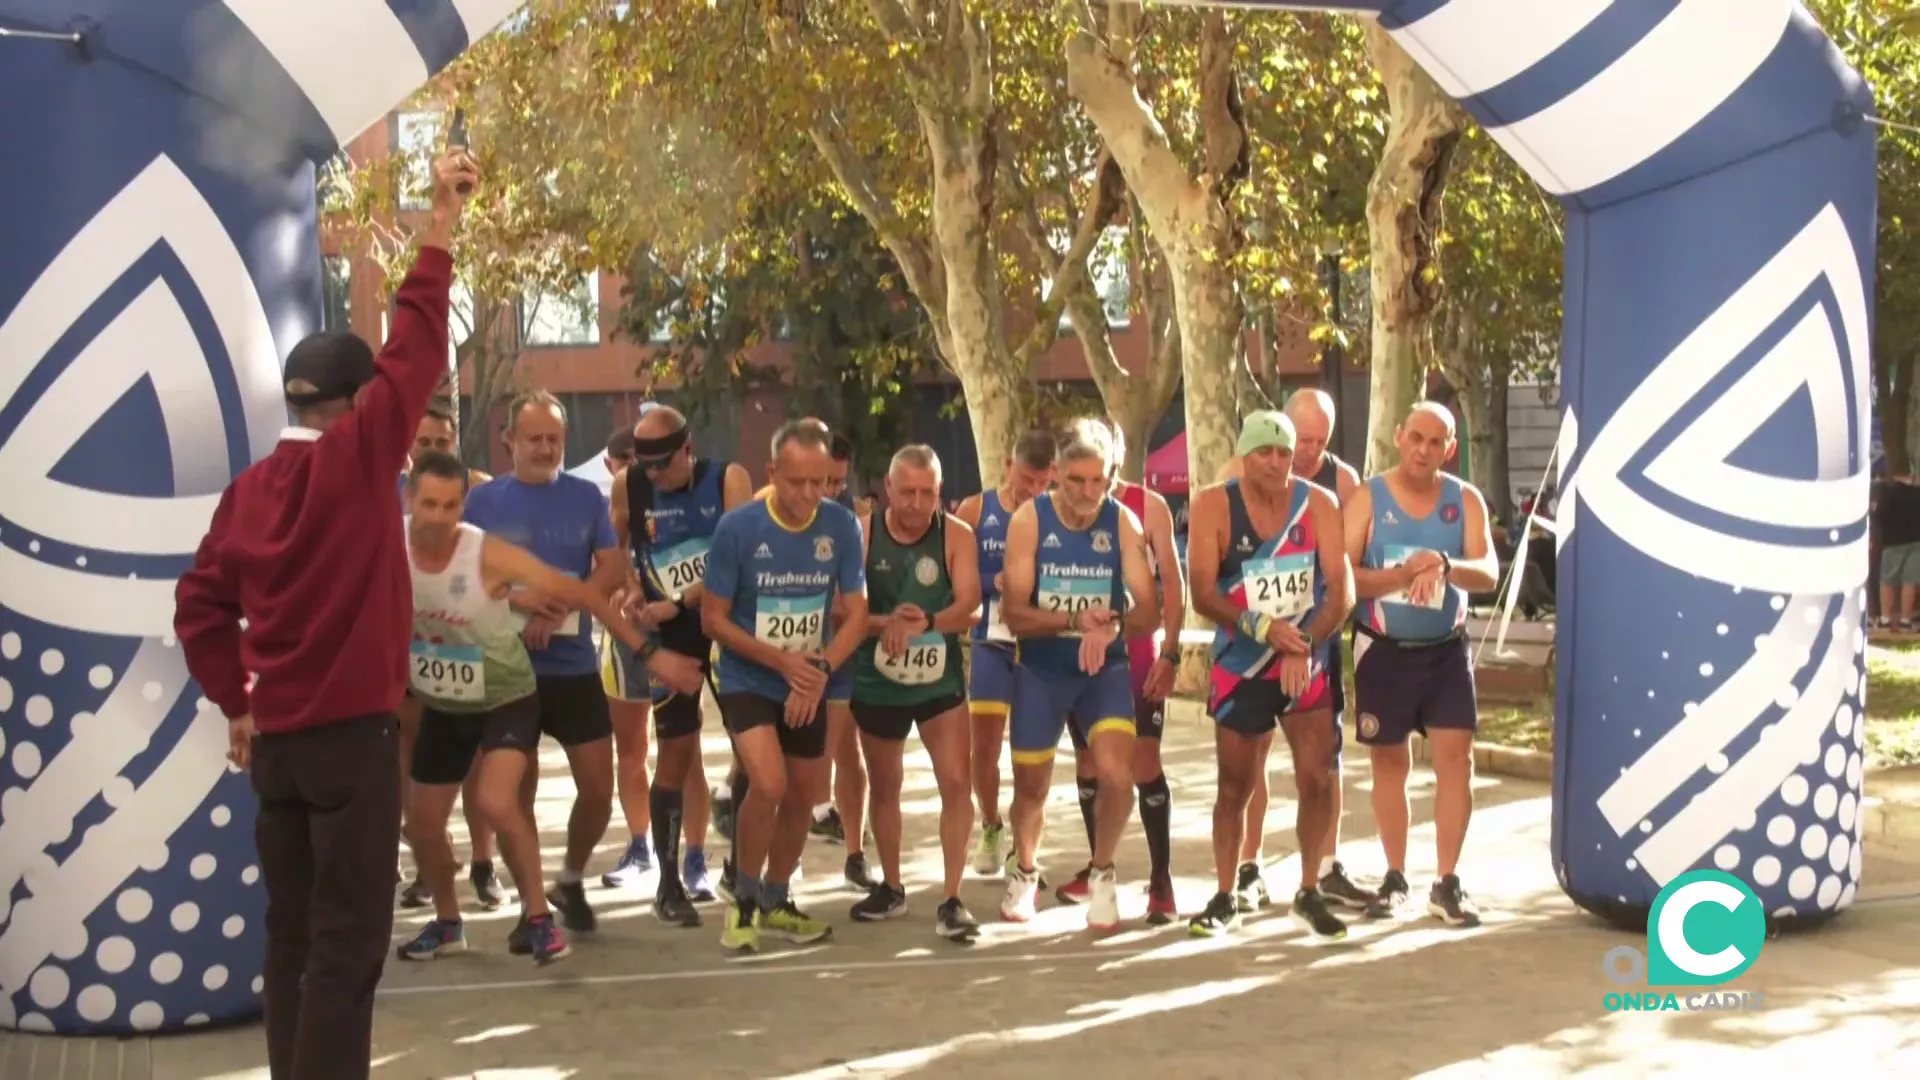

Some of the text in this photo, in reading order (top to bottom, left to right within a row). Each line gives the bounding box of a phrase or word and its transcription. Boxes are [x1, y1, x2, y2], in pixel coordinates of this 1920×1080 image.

[1255, 571, 1309, 602] 2145
[766, 612, 820, 639] 2049
[416, 656, 475, 685] 2010
